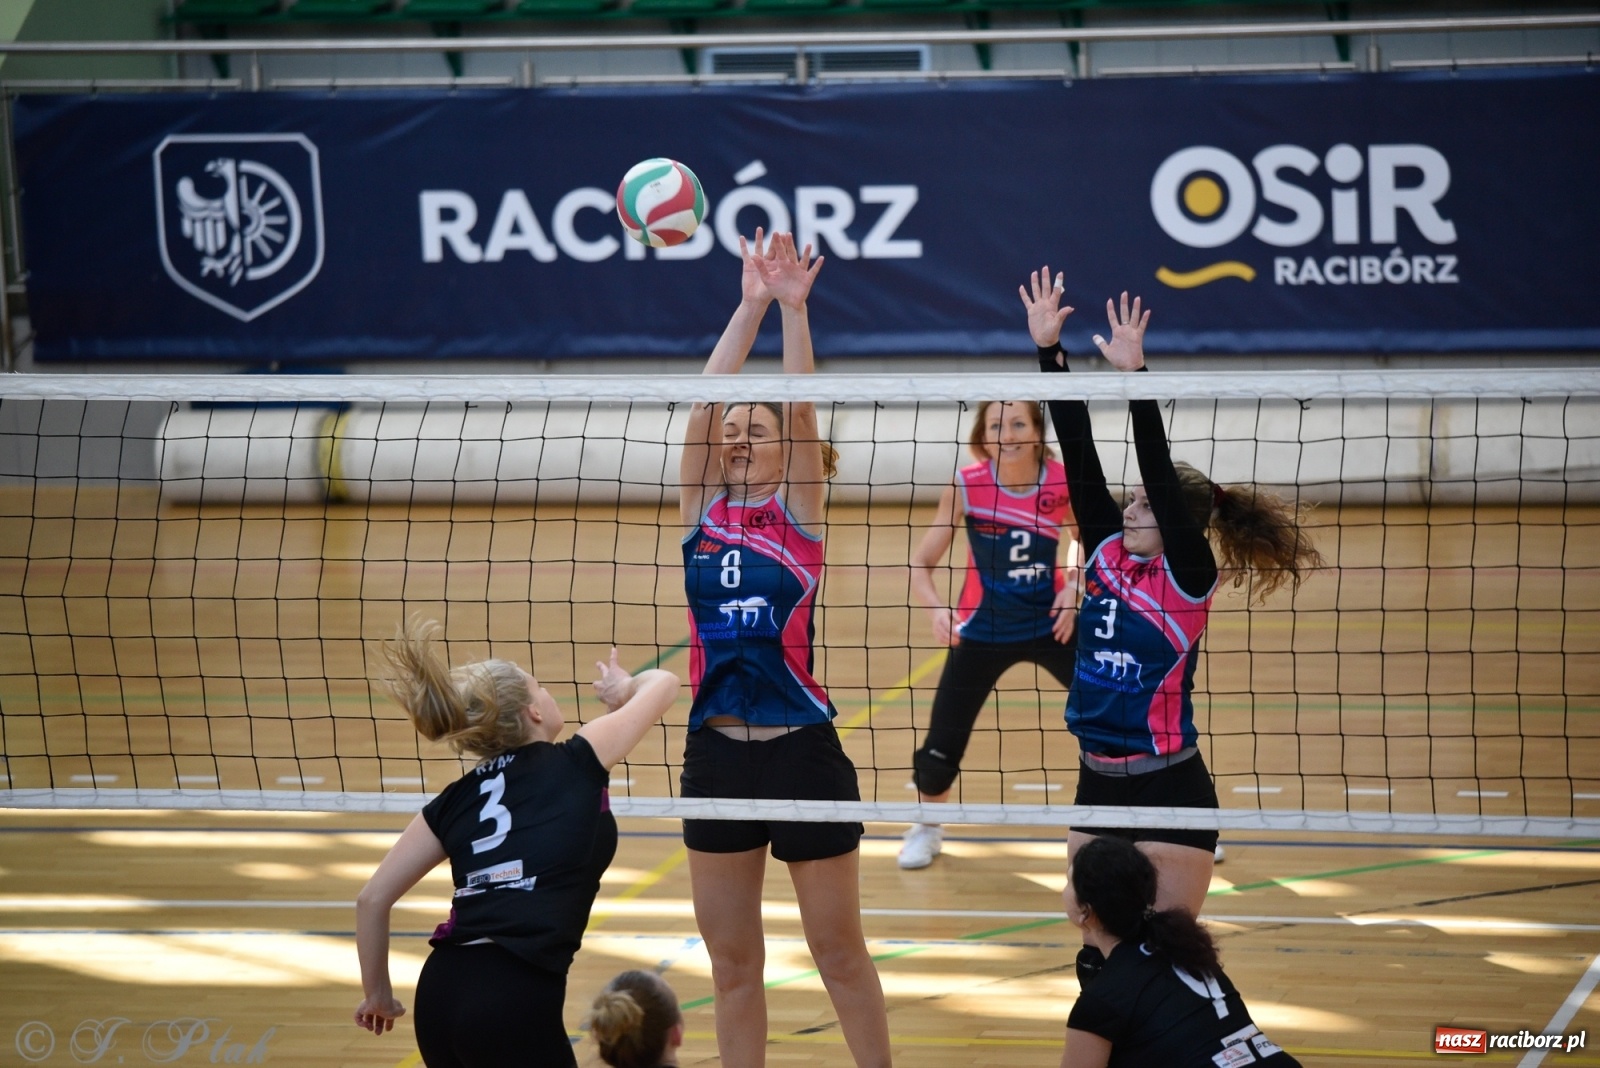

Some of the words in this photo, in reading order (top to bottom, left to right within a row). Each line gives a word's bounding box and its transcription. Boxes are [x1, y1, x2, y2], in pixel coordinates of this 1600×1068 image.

[1274, 247, 1459, 285] RACIBÓRZ
[1009, 530, 1031, 562] 2
[720, 549, 741, 589] 8
[1094, 598, 1118, 640] 3
[471, 771, 512, 855] 3
